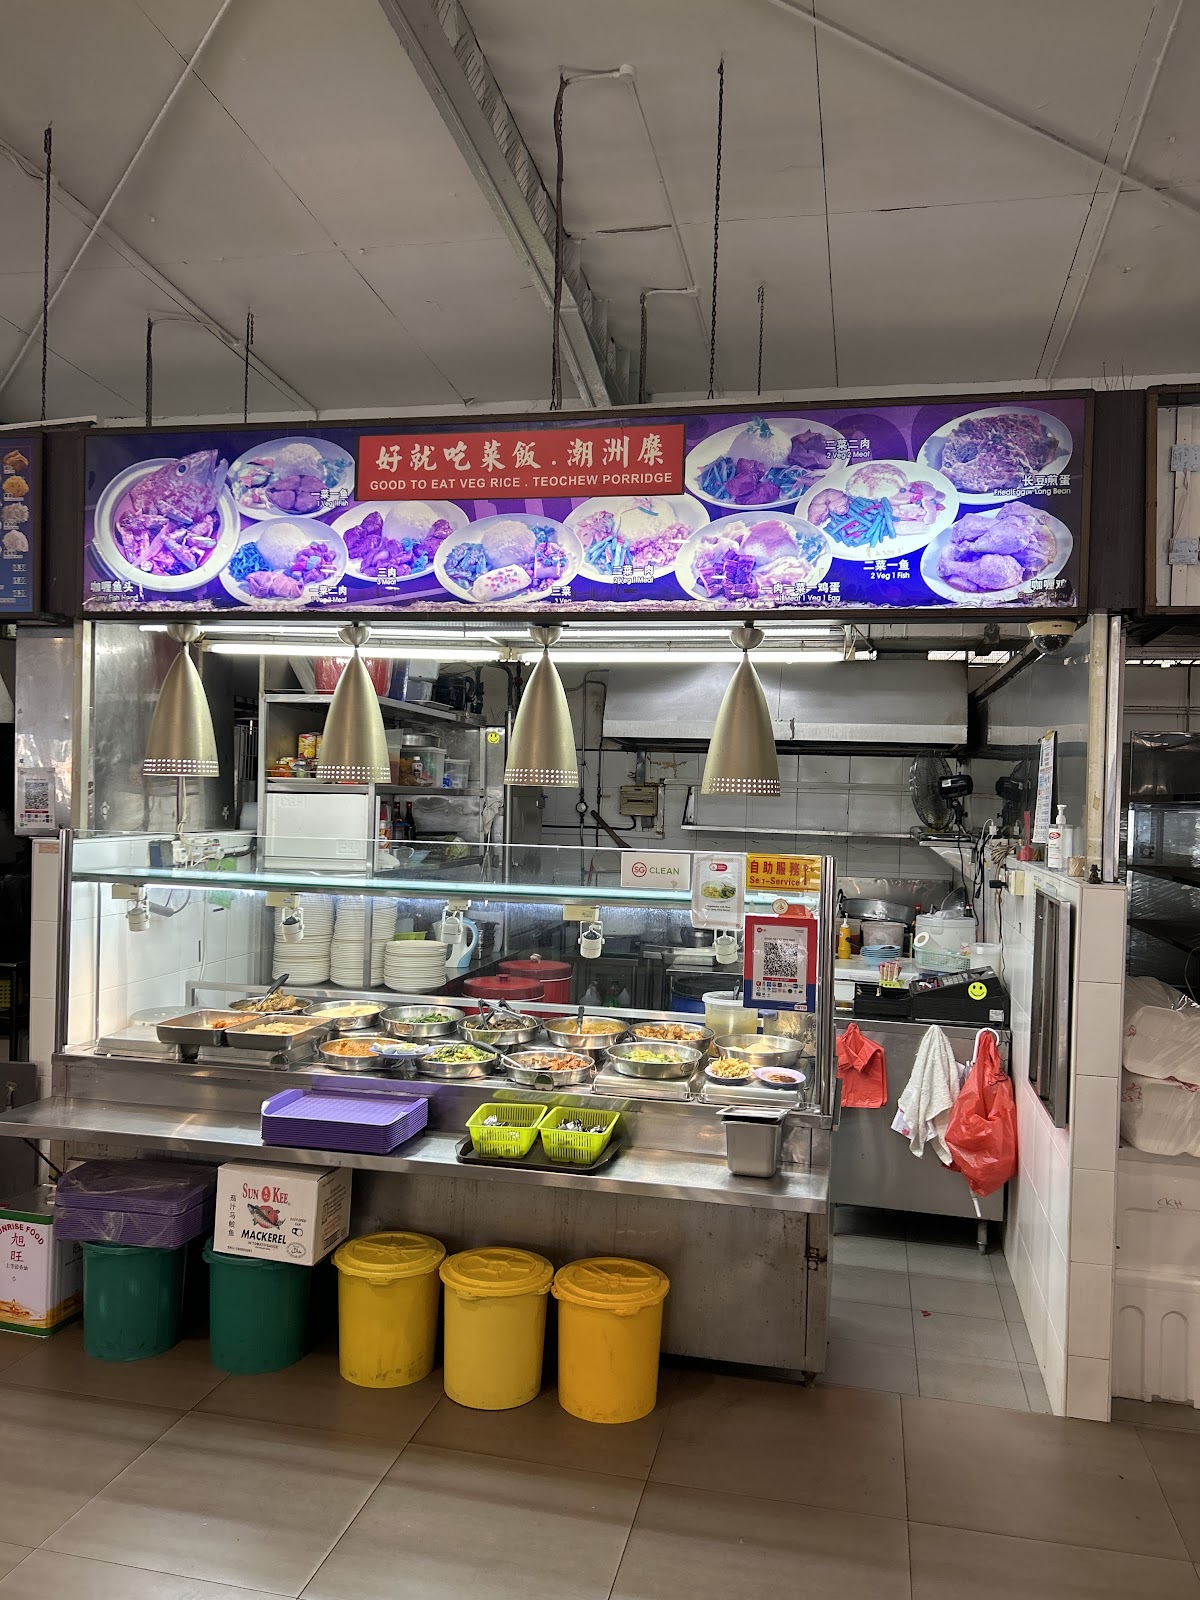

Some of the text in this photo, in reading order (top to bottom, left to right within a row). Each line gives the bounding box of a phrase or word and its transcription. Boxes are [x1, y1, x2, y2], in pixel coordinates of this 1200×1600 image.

[825, 438, 870, 450] 二菜二肉
[833, 452, 847, 460] Veg
[370, 480, 406, 490] GOOD
[410, 480, 426, 489] TO
[431, 479, 456, 489] EAT
[460, 478, 486, 488] VEG
[490, 477, 520, 487] RICE
[533, 475, 599, 486] TEOCHEW
[603, 473, 672, 484] PORRIDGE
[1022, 474, 1071, 486] 长豆煎蛋
[310, 488, 348, 500] 一菜一鱼
[1035, 488, 1051, 496] Long
[321, 500, 333, 508] Veg
[612, 564, 654, 575] 二菜一肉
[863, 559, 910, 571] 二菜一鱼
[377, 567, 397, 577] 三肉
[877, 572, 891, 580] Veg
[897, 571, 911, 579] Fish
[619, 577, 632, 585] Veg
[309, 584, 347, 596] 一菜二肉
[551, 586, 571, 597] 三菜
[761, 582, 840, 594] 一肉一菜一鸡蛋
[634, 866, 680, 875] SG CLEAN
[750, 860, 800, 876] 自助服務
[242, 1183, 259, 1200] SUN
[272, 1187, 289, 1204] KEE
[26, 1226, 45, 1245] FOOD
[241, 1229, 287, 1244] MACKEREL
